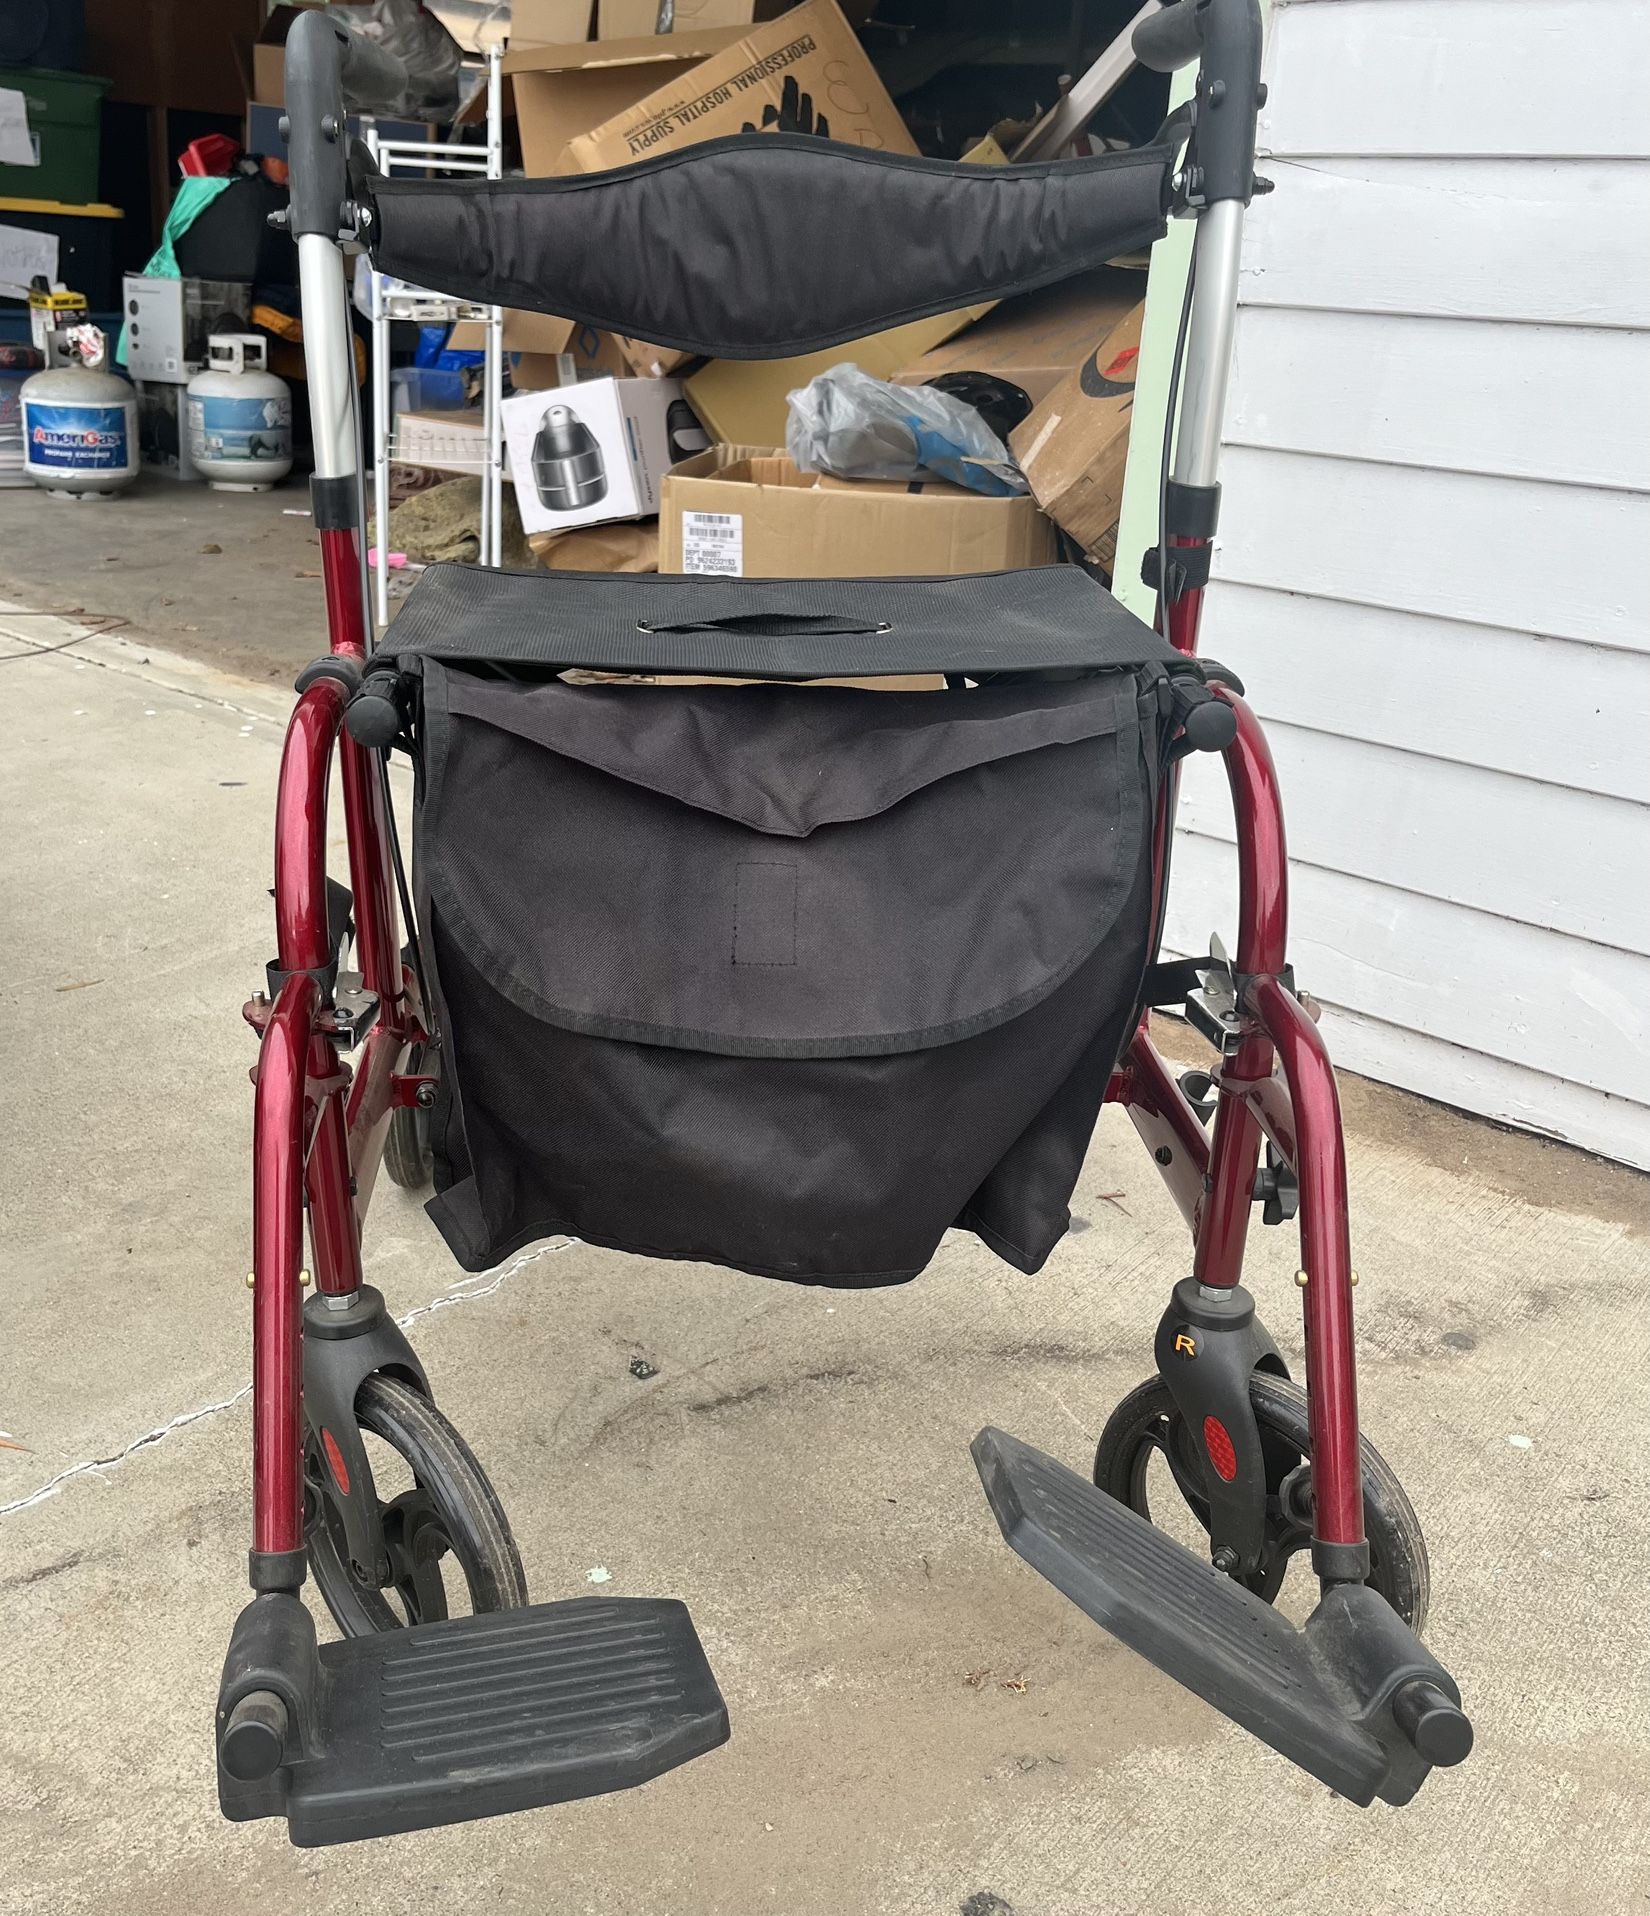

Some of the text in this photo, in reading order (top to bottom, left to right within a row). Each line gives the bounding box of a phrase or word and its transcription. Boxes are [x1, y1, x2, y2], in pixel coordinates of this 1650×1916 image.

[628, 35, 817, 157] PROFESSIONAL HOSPITAL SUPPLY
[33, 426, 120, 447] AmeriGas
[1175, 1333, 1196, 1357] R
